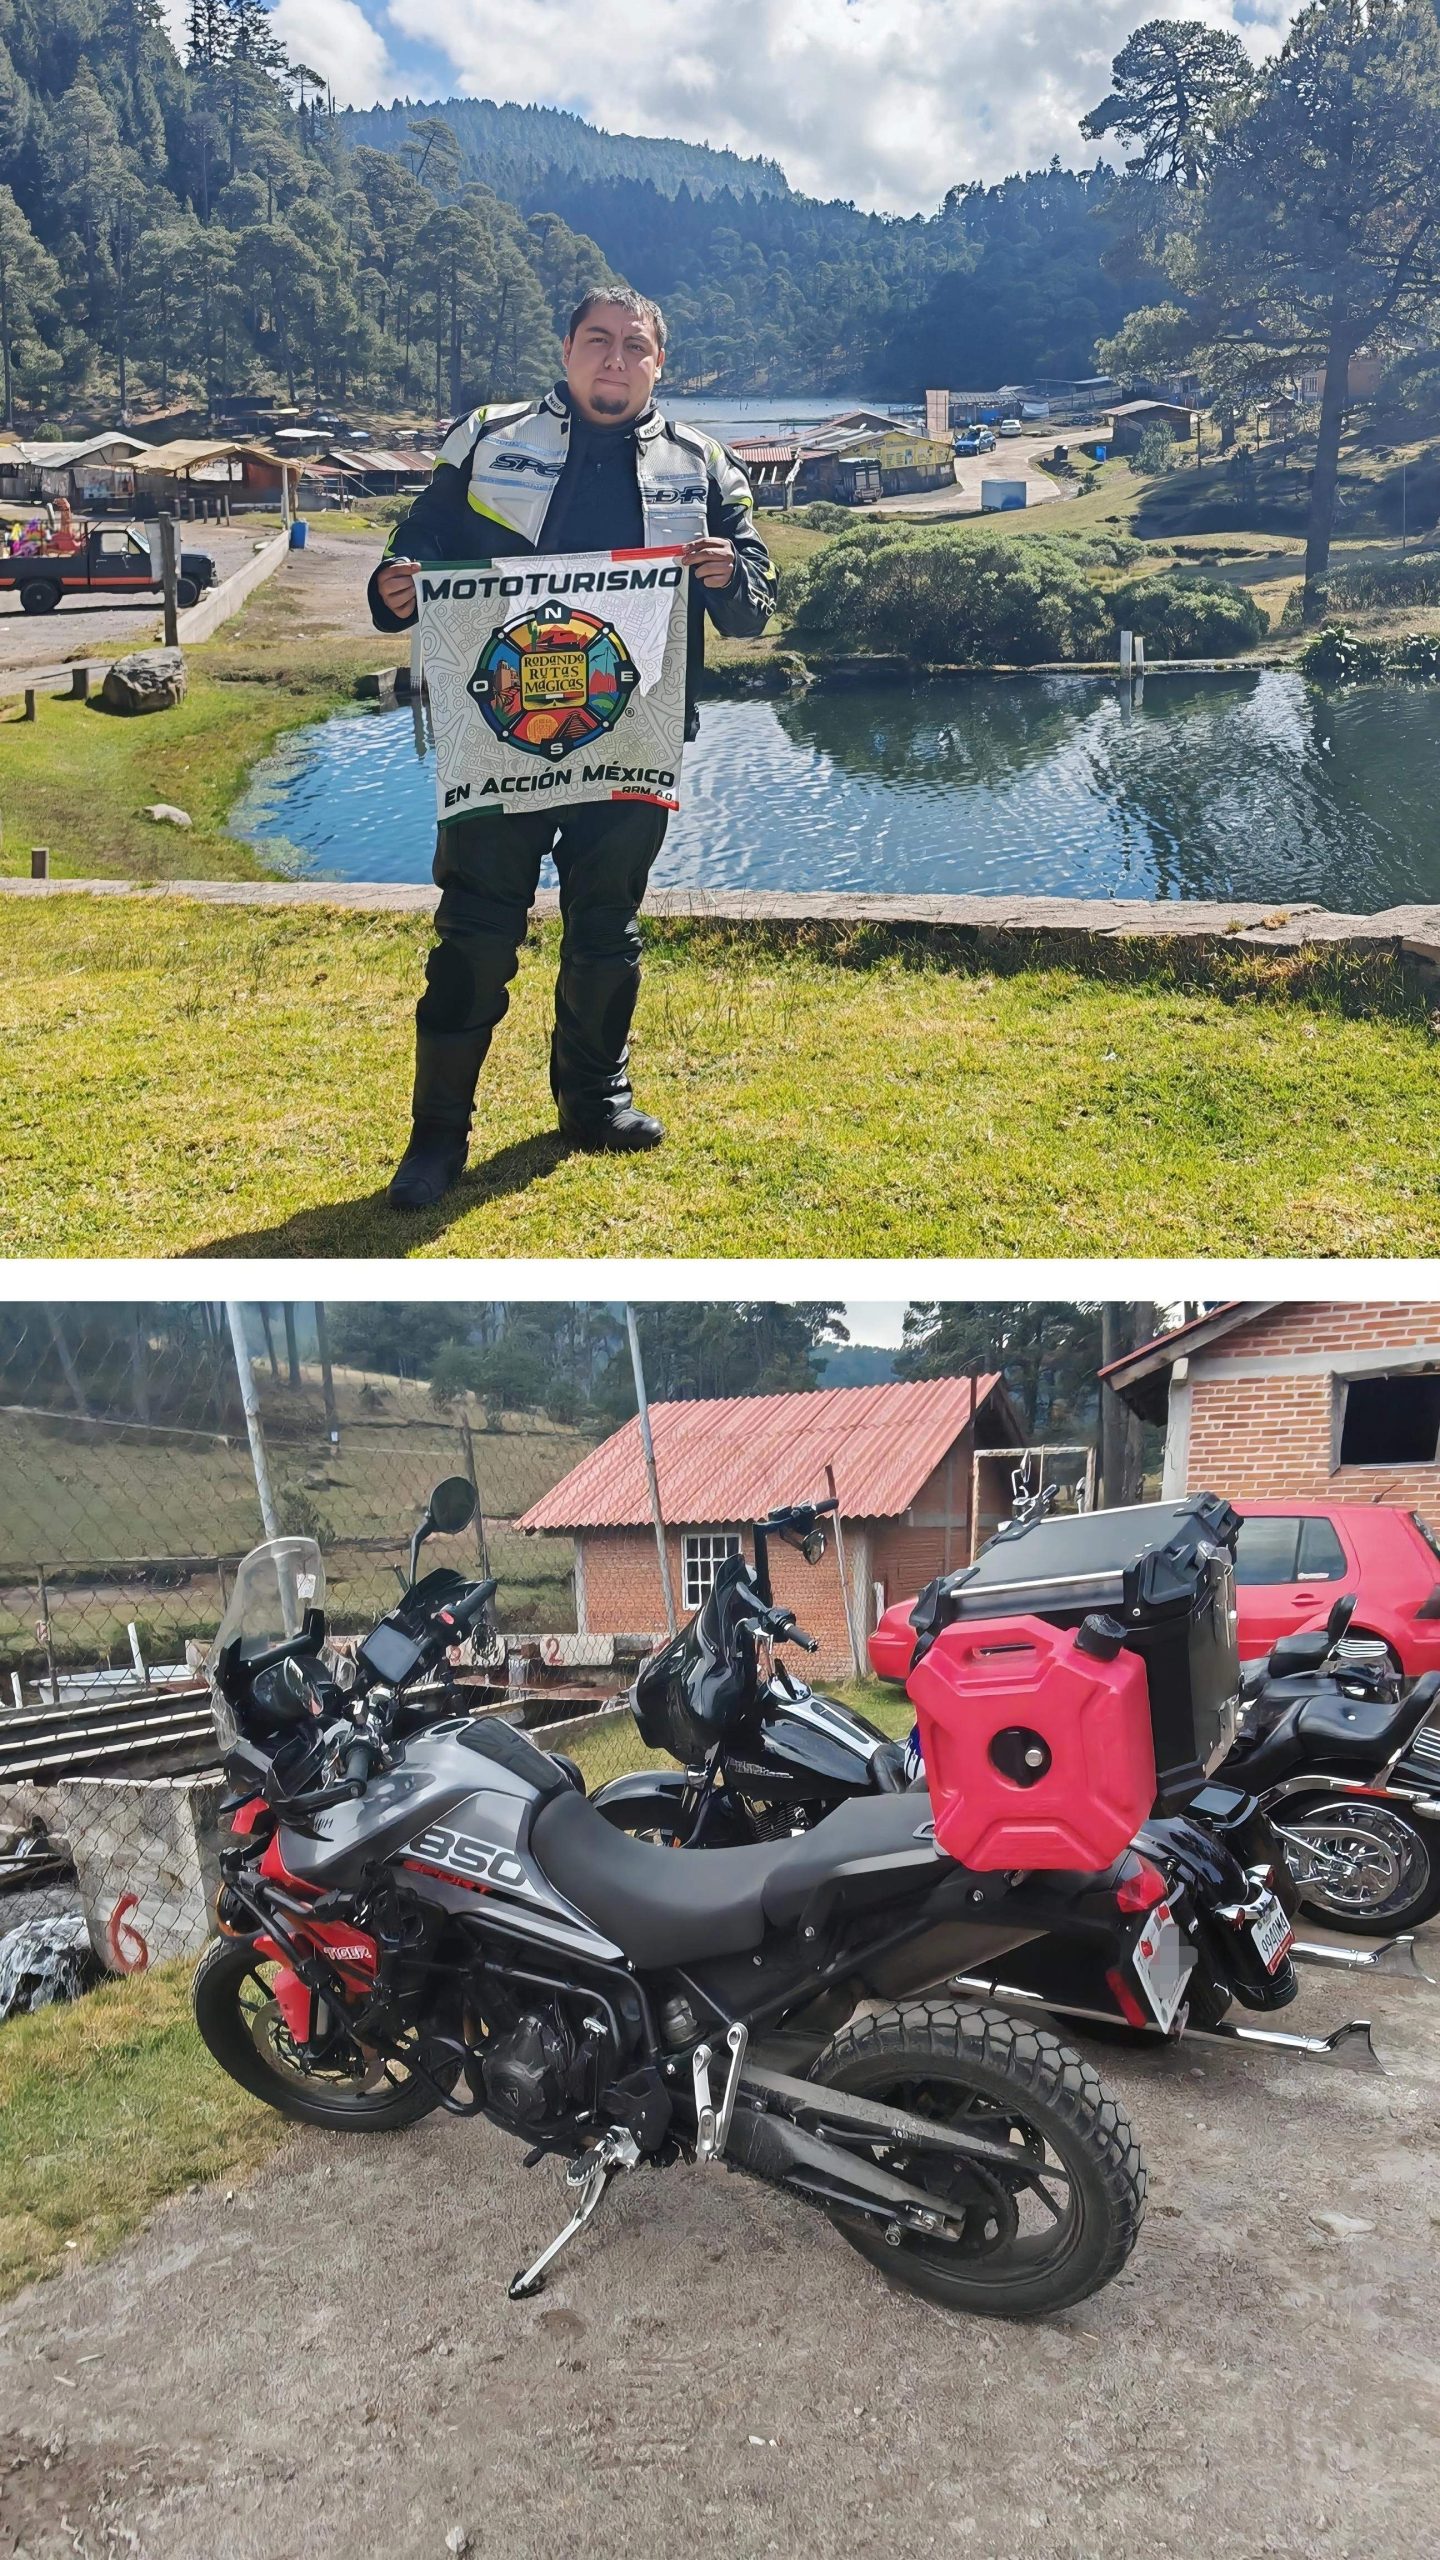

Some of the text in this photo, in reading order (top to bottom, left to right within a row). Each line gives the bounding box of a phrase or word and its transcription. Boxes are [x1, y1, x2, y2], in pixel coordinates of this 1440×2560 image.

[421, 566, 683, 603] MOTOTURISMO
[545, 607, 562, 619] N
[472, 680, 489, 693] O
[620, 670, 634, 683] E
[550, 742, 564, 755] S
[444, 761, 675, 808] EN ACCIÓN MÉXICO
[546, 1637, 564, 1666] 2
[409, 1828, 528, 1887] 850
[108, 1890, 149, 1975] 6
